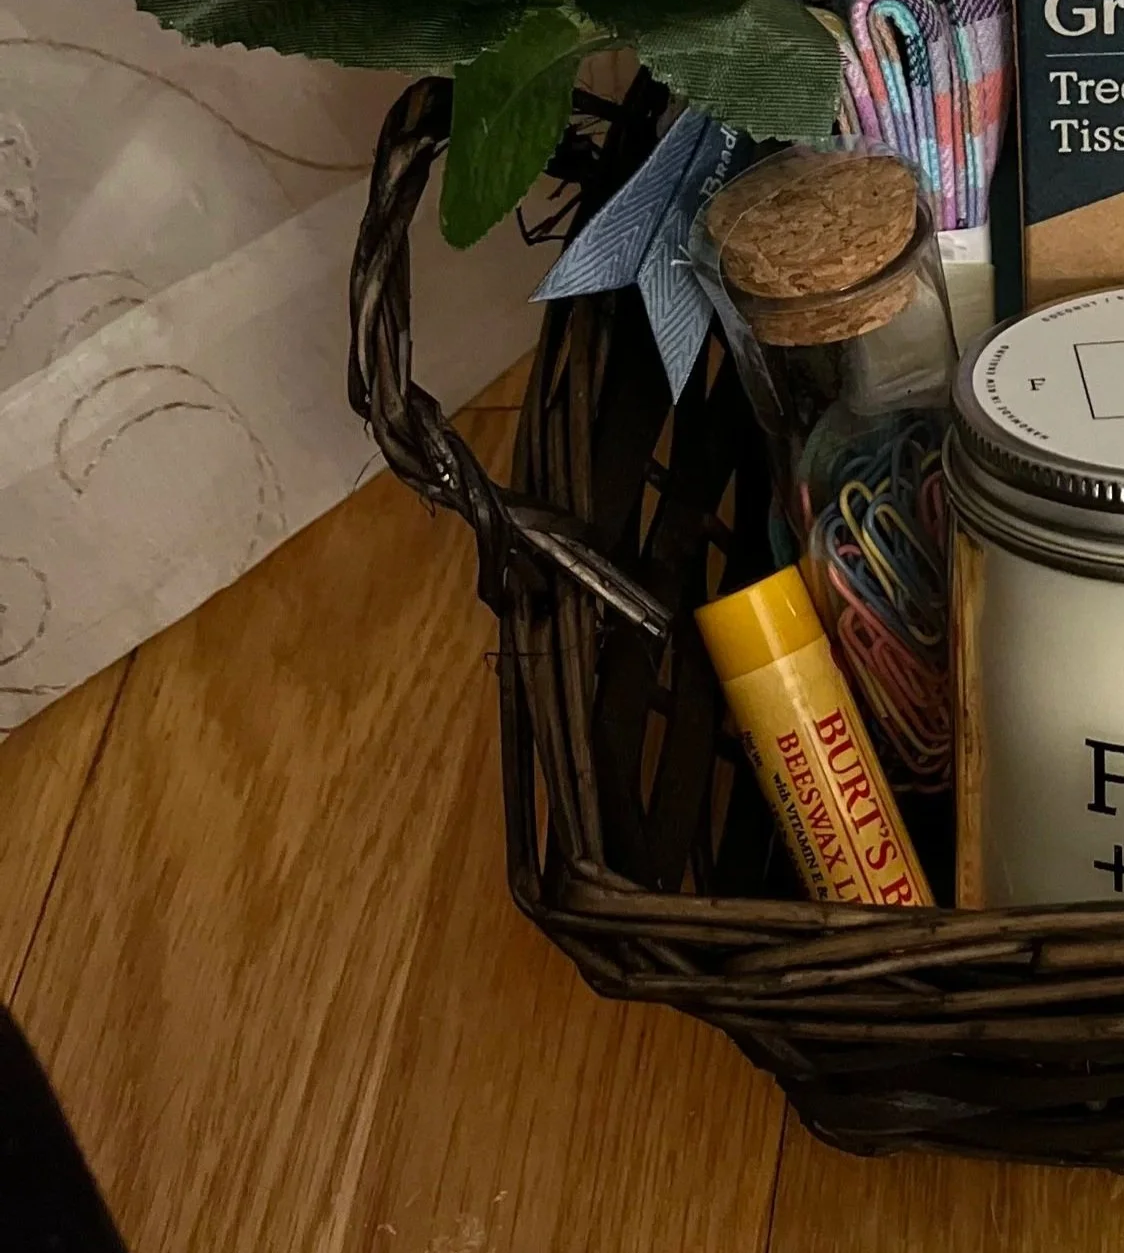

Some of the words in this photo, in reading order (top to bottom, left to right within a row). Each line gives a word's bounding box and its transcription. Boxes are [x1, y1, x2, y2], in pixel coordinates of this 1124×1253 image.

[1041, 300, 1098, 323] COCONUT
[985, 345, 1010, 376] ENGLAND
[985, 378, 997, 393] NEW
[1028, 377, 1046, 391] F
[996, 406, 1049, 440] HANDMADE
[776, 728, 849, 874] BEESWAX
[814, 707, 899, 871] BURT'S
[772, 772, 792, 804] with
[785, 802, 820, 869] VITAMIN
[811, 871, 825, 884] E
